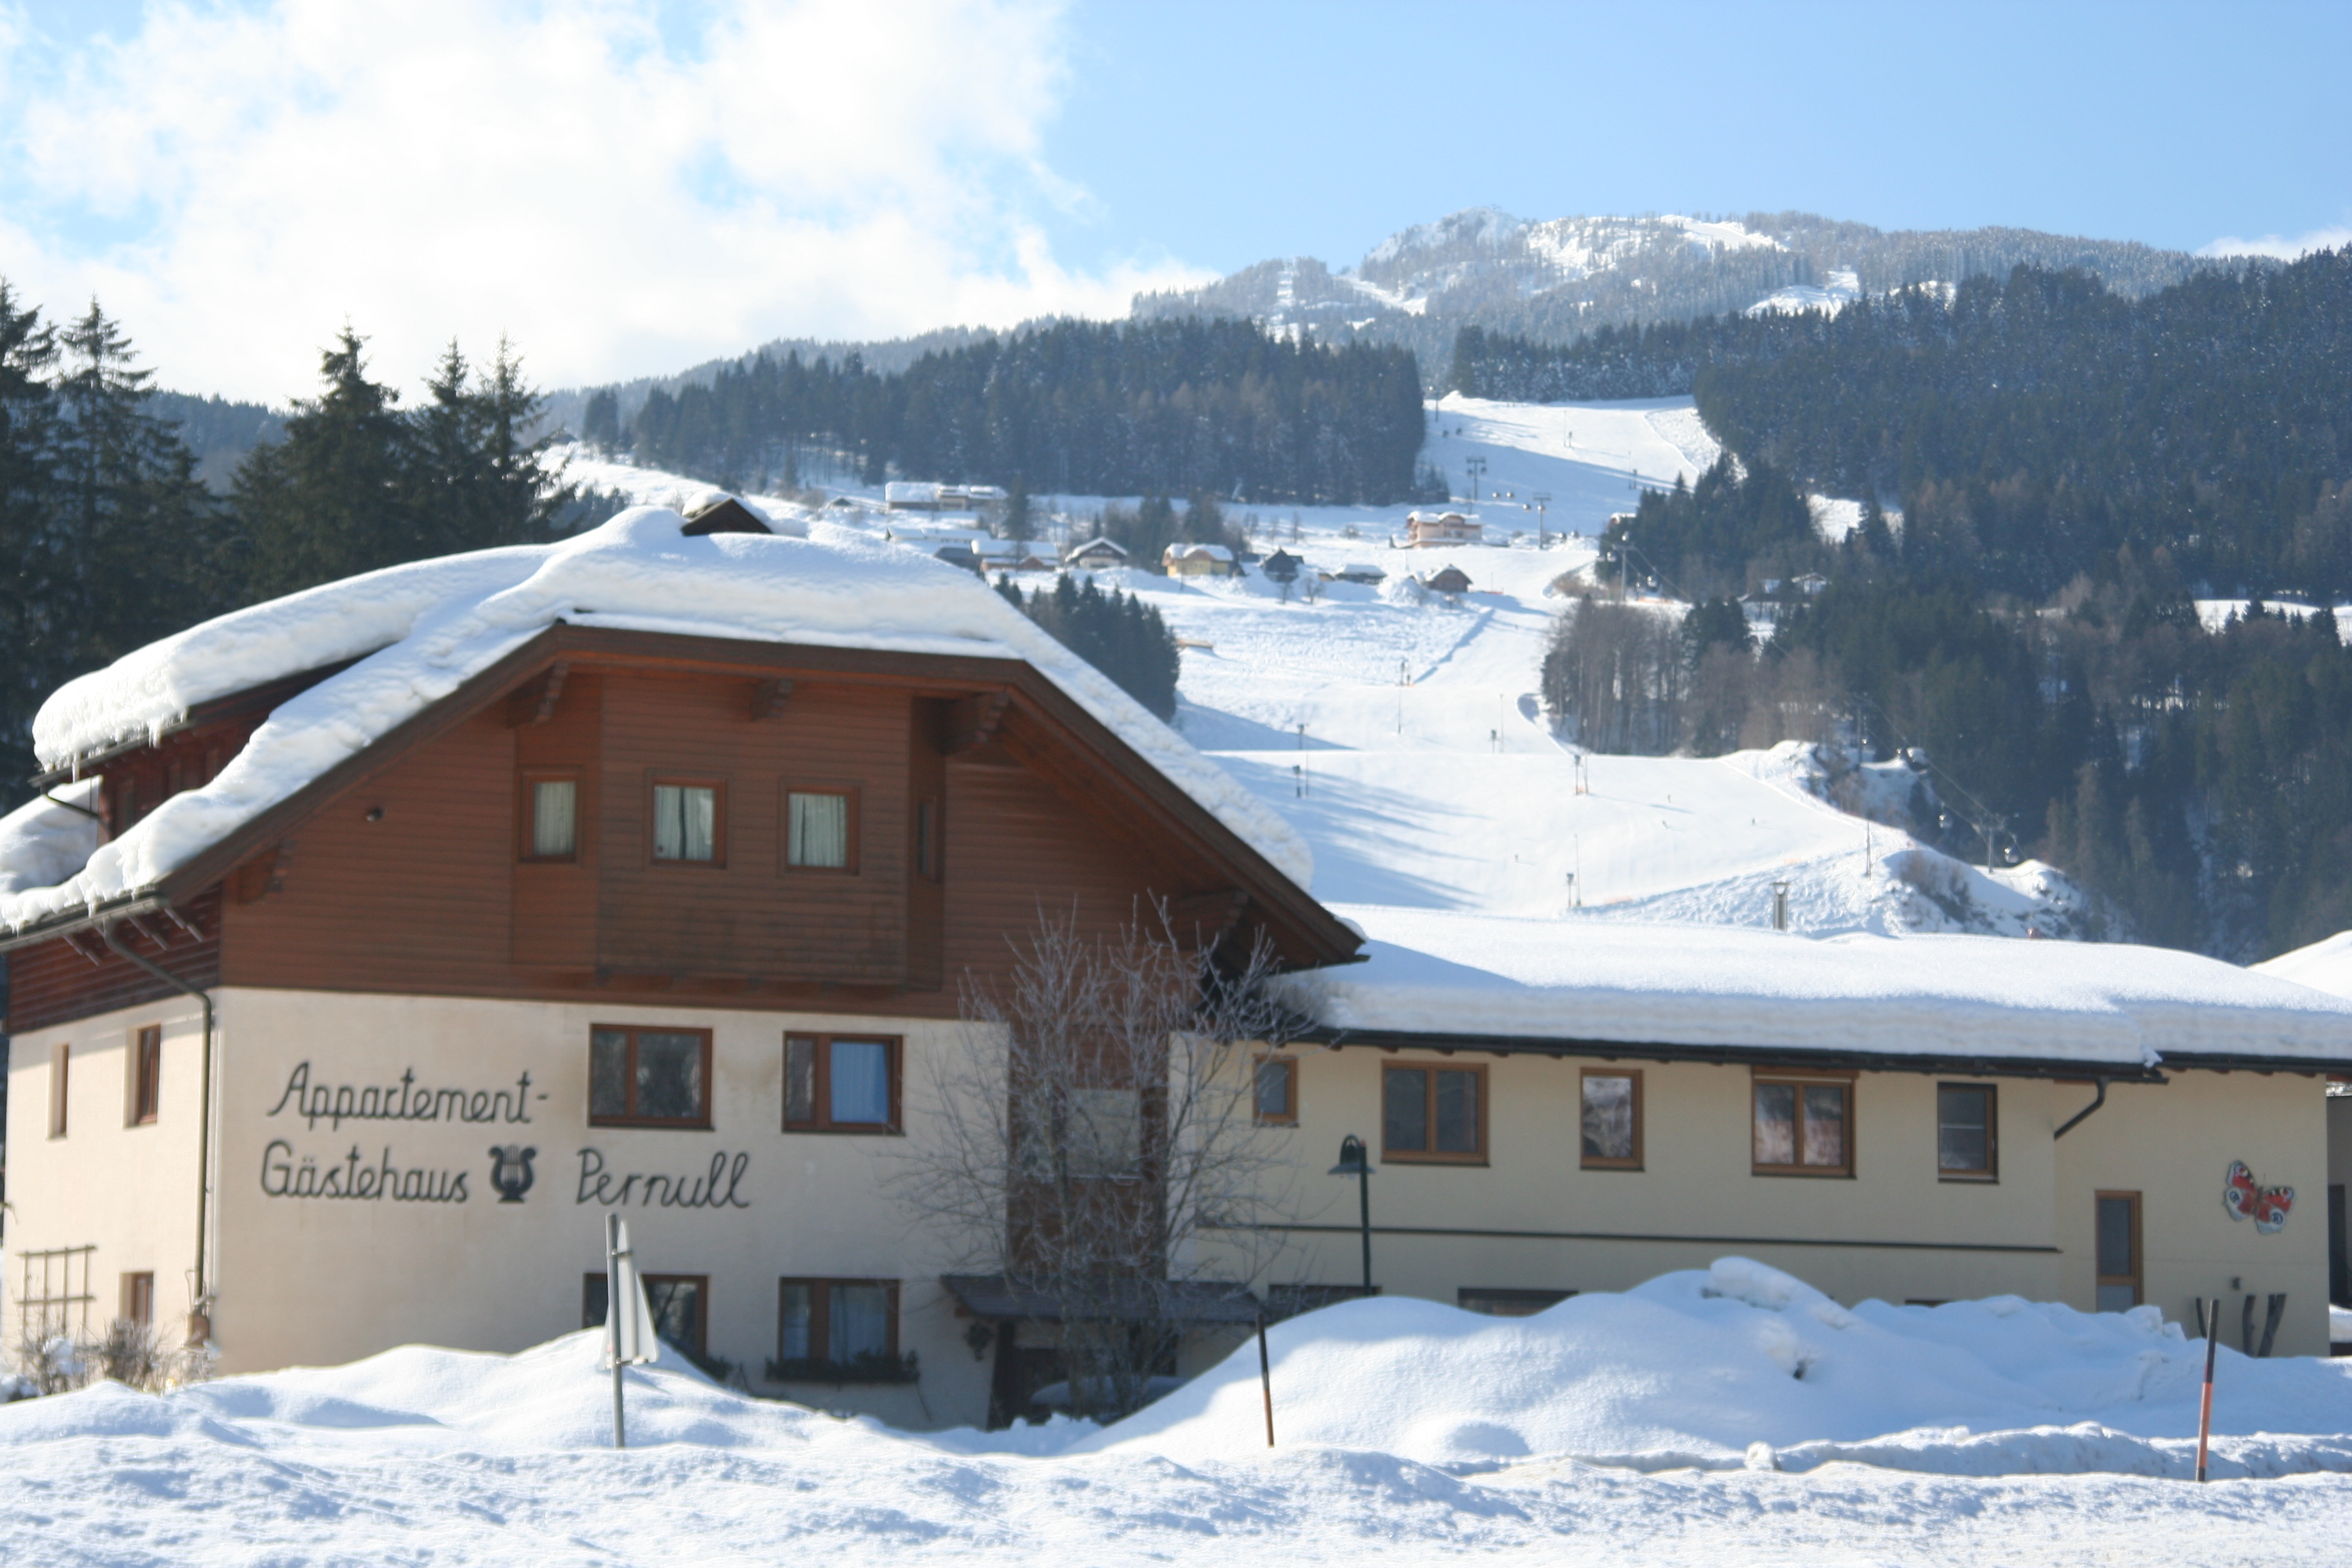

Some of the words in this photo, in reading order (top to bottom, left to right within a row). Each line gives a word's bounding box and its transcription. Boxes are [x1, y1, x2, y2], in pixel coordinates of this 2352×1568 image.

[266, 1060, 549, 1132] Appartement-
[260, 1139, 470, 1204] Gästehaus
[576, 1147, 751, 1209] Pernull
